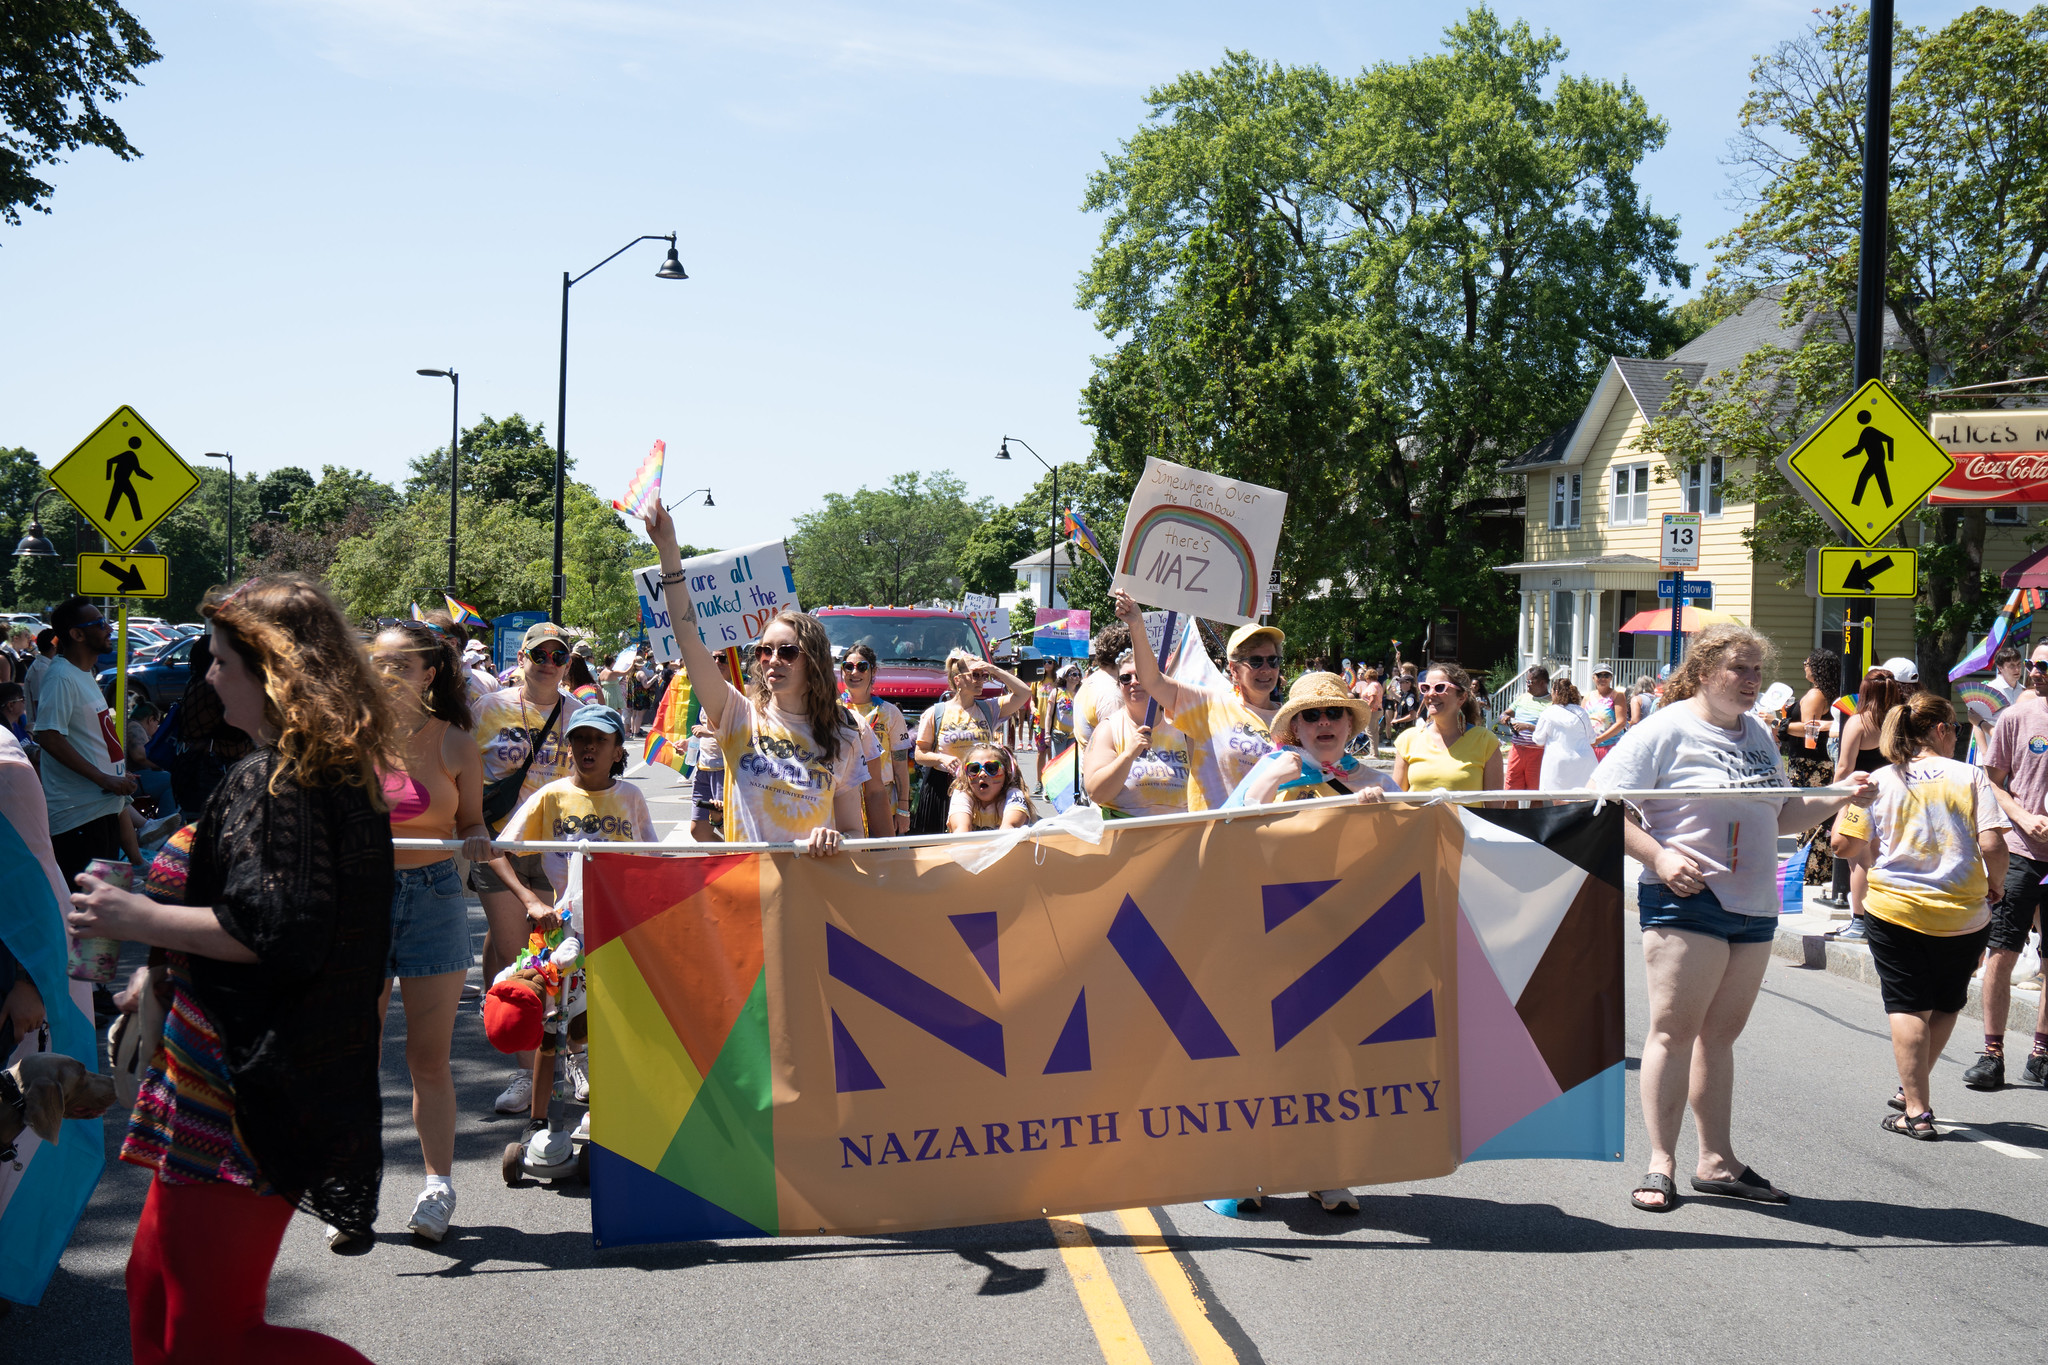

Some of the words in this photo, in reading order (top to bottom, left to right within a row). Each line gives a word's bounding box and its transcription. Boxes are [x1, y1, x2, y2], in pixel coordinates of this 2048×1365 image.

[1965, 455, 2048, 481] Coca-Cola
[1151, 463, 1215, 497] Somewhere
[1225, 486, 1261, 505] Over
[1164, 491, 1178, 505] the
[1165, 526, 1211, 553] there's
[1670, 528, 1694, 545] 13
[691, 574, 717, 593] are
[730, 555, 753, 584] all
[1145, 550, 1211, 593] NAZ
[697, 589, 742, 619] naked
[750, 584, 777, 607] the
[1660, 583, 1703, 594] Laslow
[970, 610, 998, 624] OVE
[719, 623, 737, 642] is
[1711, 749, 1772, 766] TRANS
[739, 752, 834, 792] EQUALITY
[749, 780, 781, 794] NAZARETH
[782, 789, 818, 802] UNIVERSITY
[553, 814, 633, 840] BOOGIE
[825, 871, 1438, 1094] NAZ
[838, 1110, 1121, 1169] NAZARETH
[1138, 1079, 1442, 1140] UNIVERSITY
